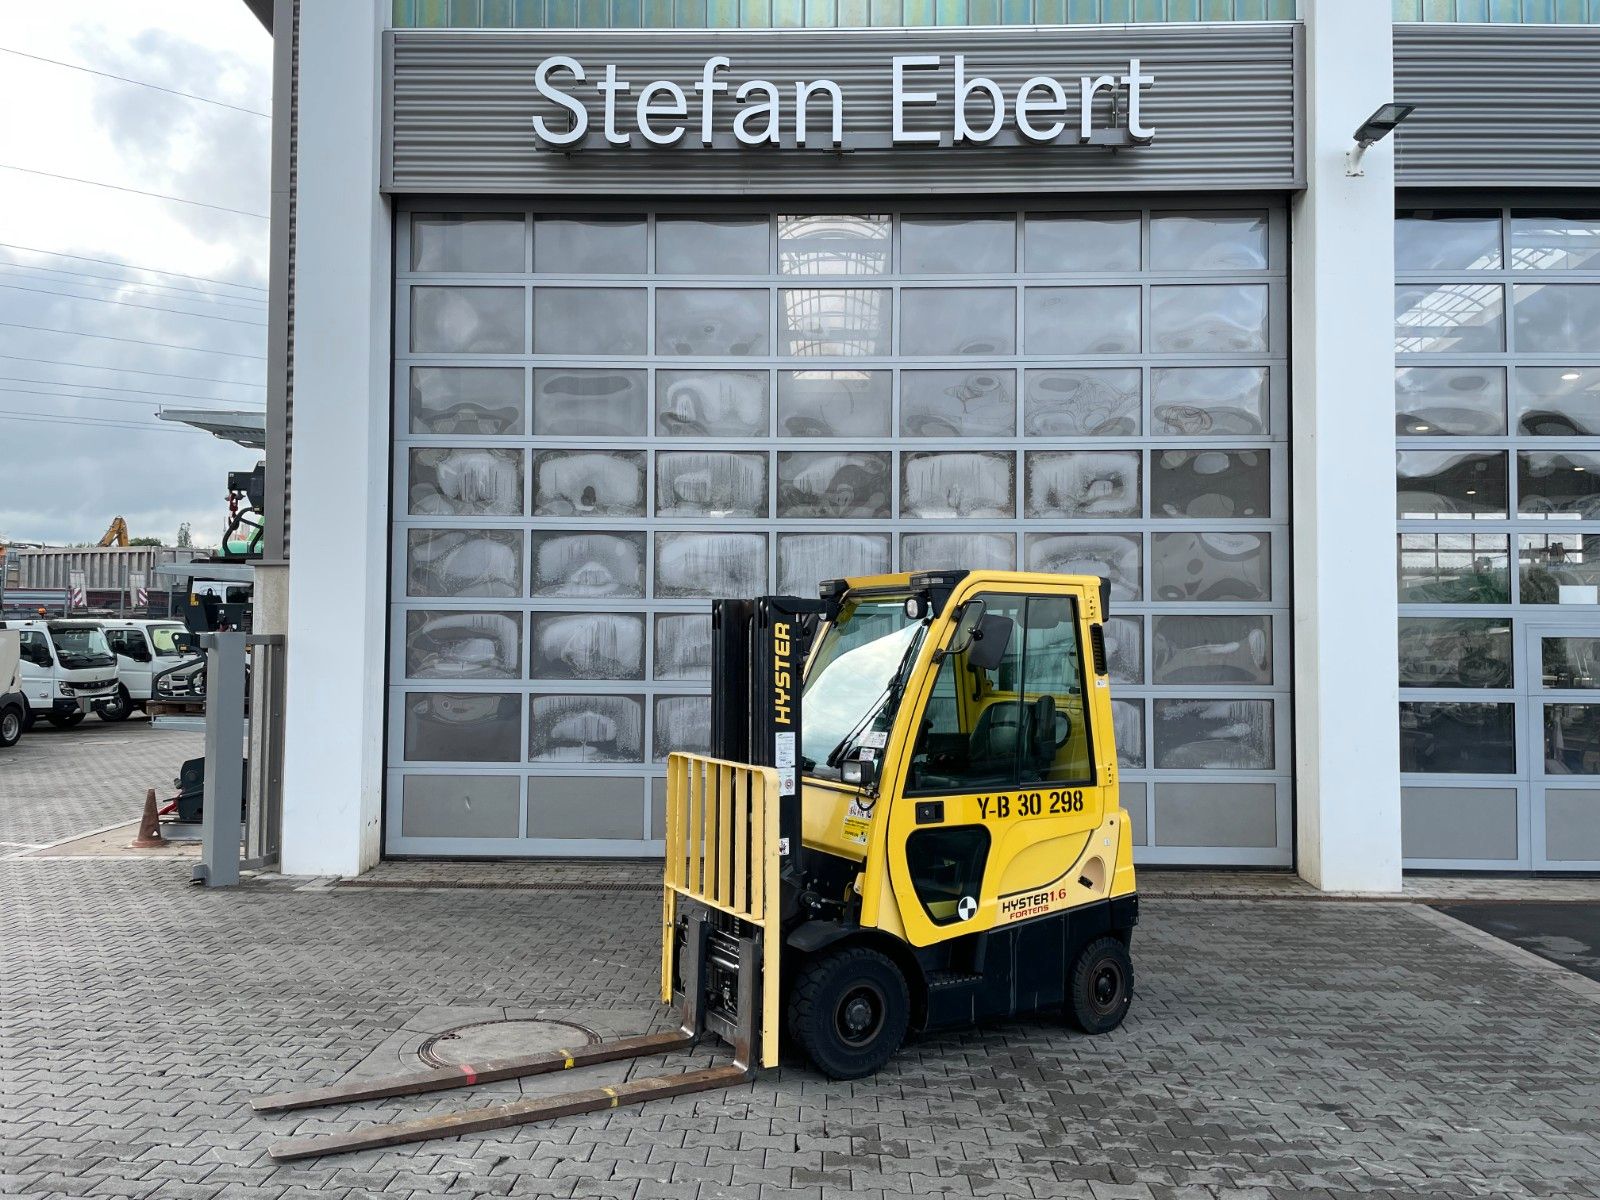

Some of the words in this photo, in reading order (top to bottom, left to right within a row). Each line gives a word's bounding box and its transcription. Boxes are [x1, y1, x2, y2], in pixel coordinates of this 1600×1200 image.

[532, 55, 843, 148] Stefan
[892, 54, 1156, 145] Ebert
[774, 622, 791, 725] HYSTER
[976, 795, 1010, 819] Y-B
[1017, 792, 1042, 817] 30
[1049, 789, 1084, 814] 298
[1002, 892, 1050, 914] HYSTER
[1049, 888, 1067, 902] 1.6
[1009, 904, 1050, 920] FORTENS
